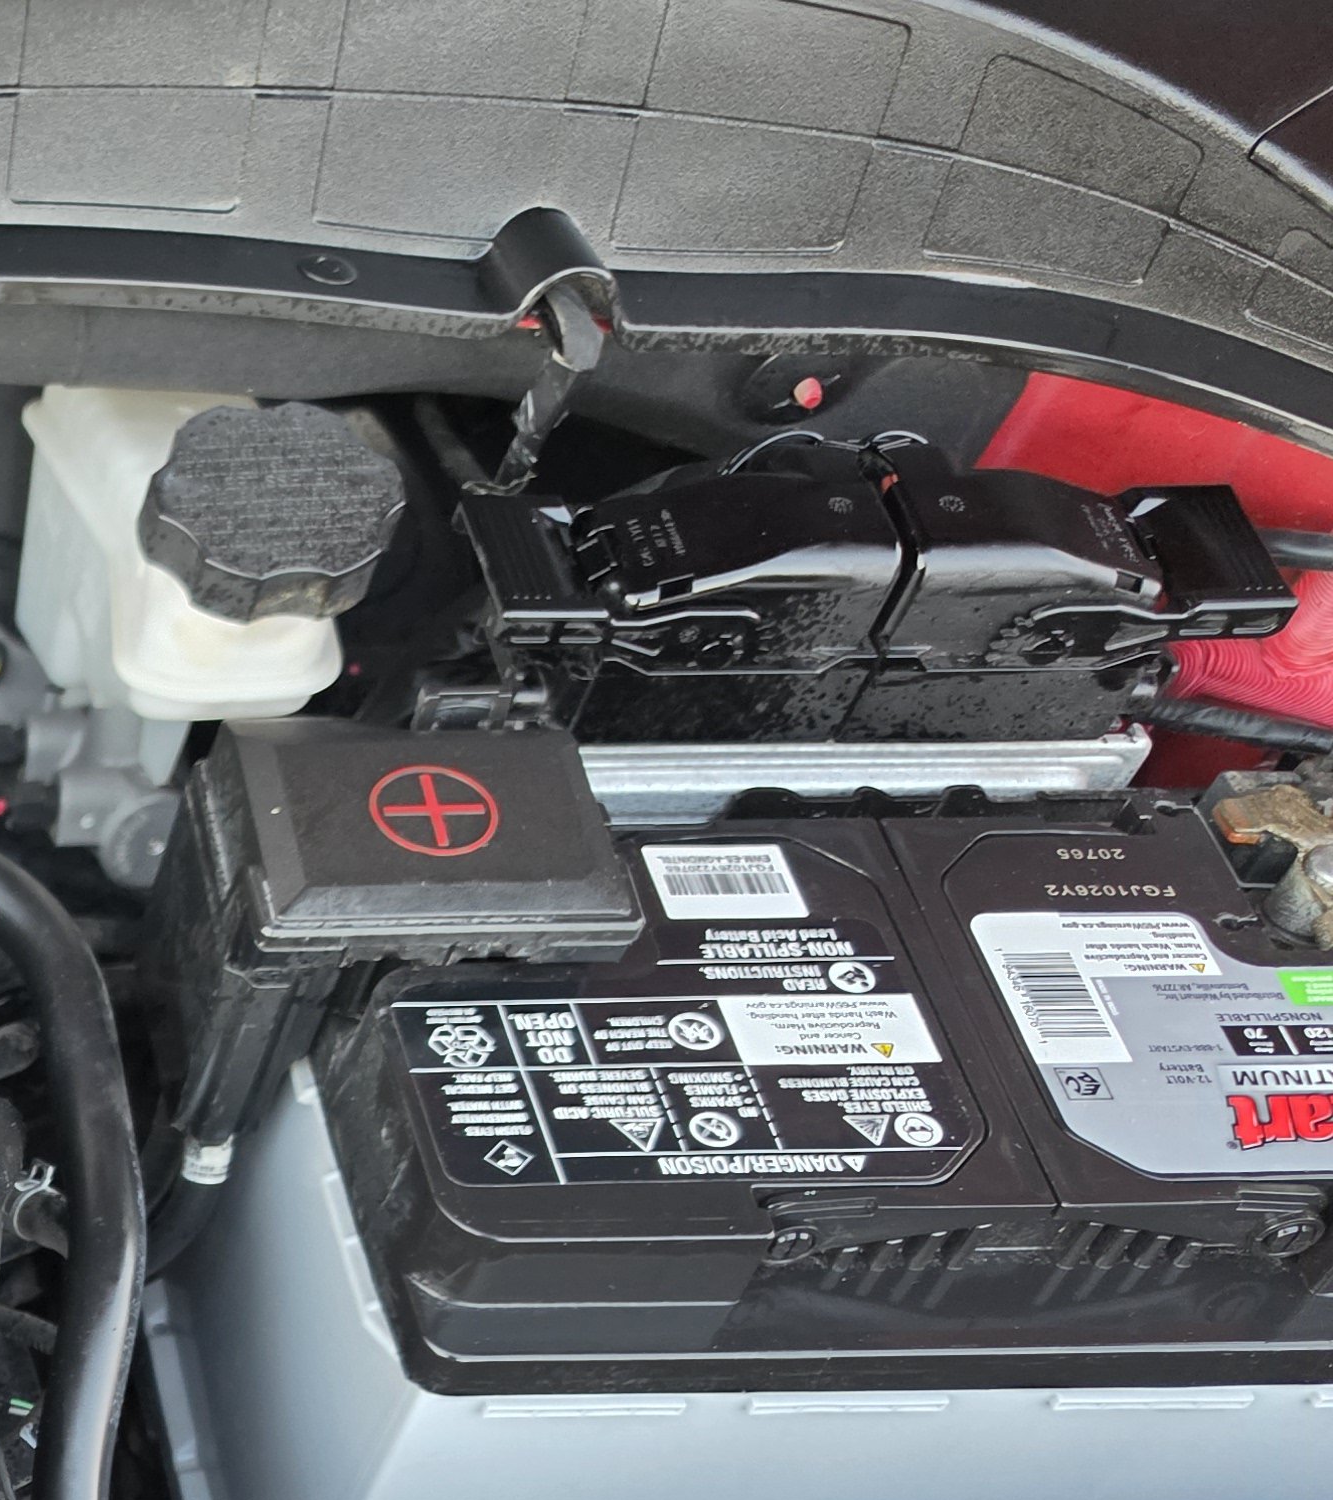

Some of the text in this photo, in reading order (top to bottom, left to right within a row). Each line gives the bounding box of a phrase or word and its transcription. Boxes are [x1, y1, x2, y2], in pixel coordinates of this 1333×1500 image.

[1056, 848, 1125, 860] 20765
[1044, 884, 1177, 897] FGJ1026Y2
[705, 928, 837, 942] Lead Acid Battery
[698, 940, 854, 959] NON-SPILLABLE
[698, 965, 822, 979] INSTRUCTIONS.
[782, 978, 828, 991] READ
[507, 1011, 577, 1030] OPEN.
[1215, 1012, 1322, 1022] NONSPILLABLE
[525, 1029, 576, 1047] NOT
[799, 1033, 820, 1041] and
[1243, 1027, 1268, 1039] 70
[537, 1046, 576, 1064] DO
[775, 1044, 868, 1055] WARNING:
[1159, 1063, 1204, 1072] Battery
[598, 1069, 650, 1081] SEVERE
[667, 1072, 735, 1085] SMOKING
[1164, 1075, 1212, 1085] 12-VOLT
[578, 1081, 653, 1094] BLINDNESS
[777, 1076, 920, 1089] CAN CAUSE BLINDNESS
[683, 1084, 739, 1096] FLAMES
[801, 1088, 927, 1102] EXPLOSIVE GASES
[581, 1093, 659, 1107] CAN CAUSE
[689, 1095, 743, 1107] SPARKS
[882, 1100, 932, 1113] SHIELD
[552, 1105, 664, 1120] SULFURIC ACID
[657, 1155, 845, 1175] DANGER/POISON
